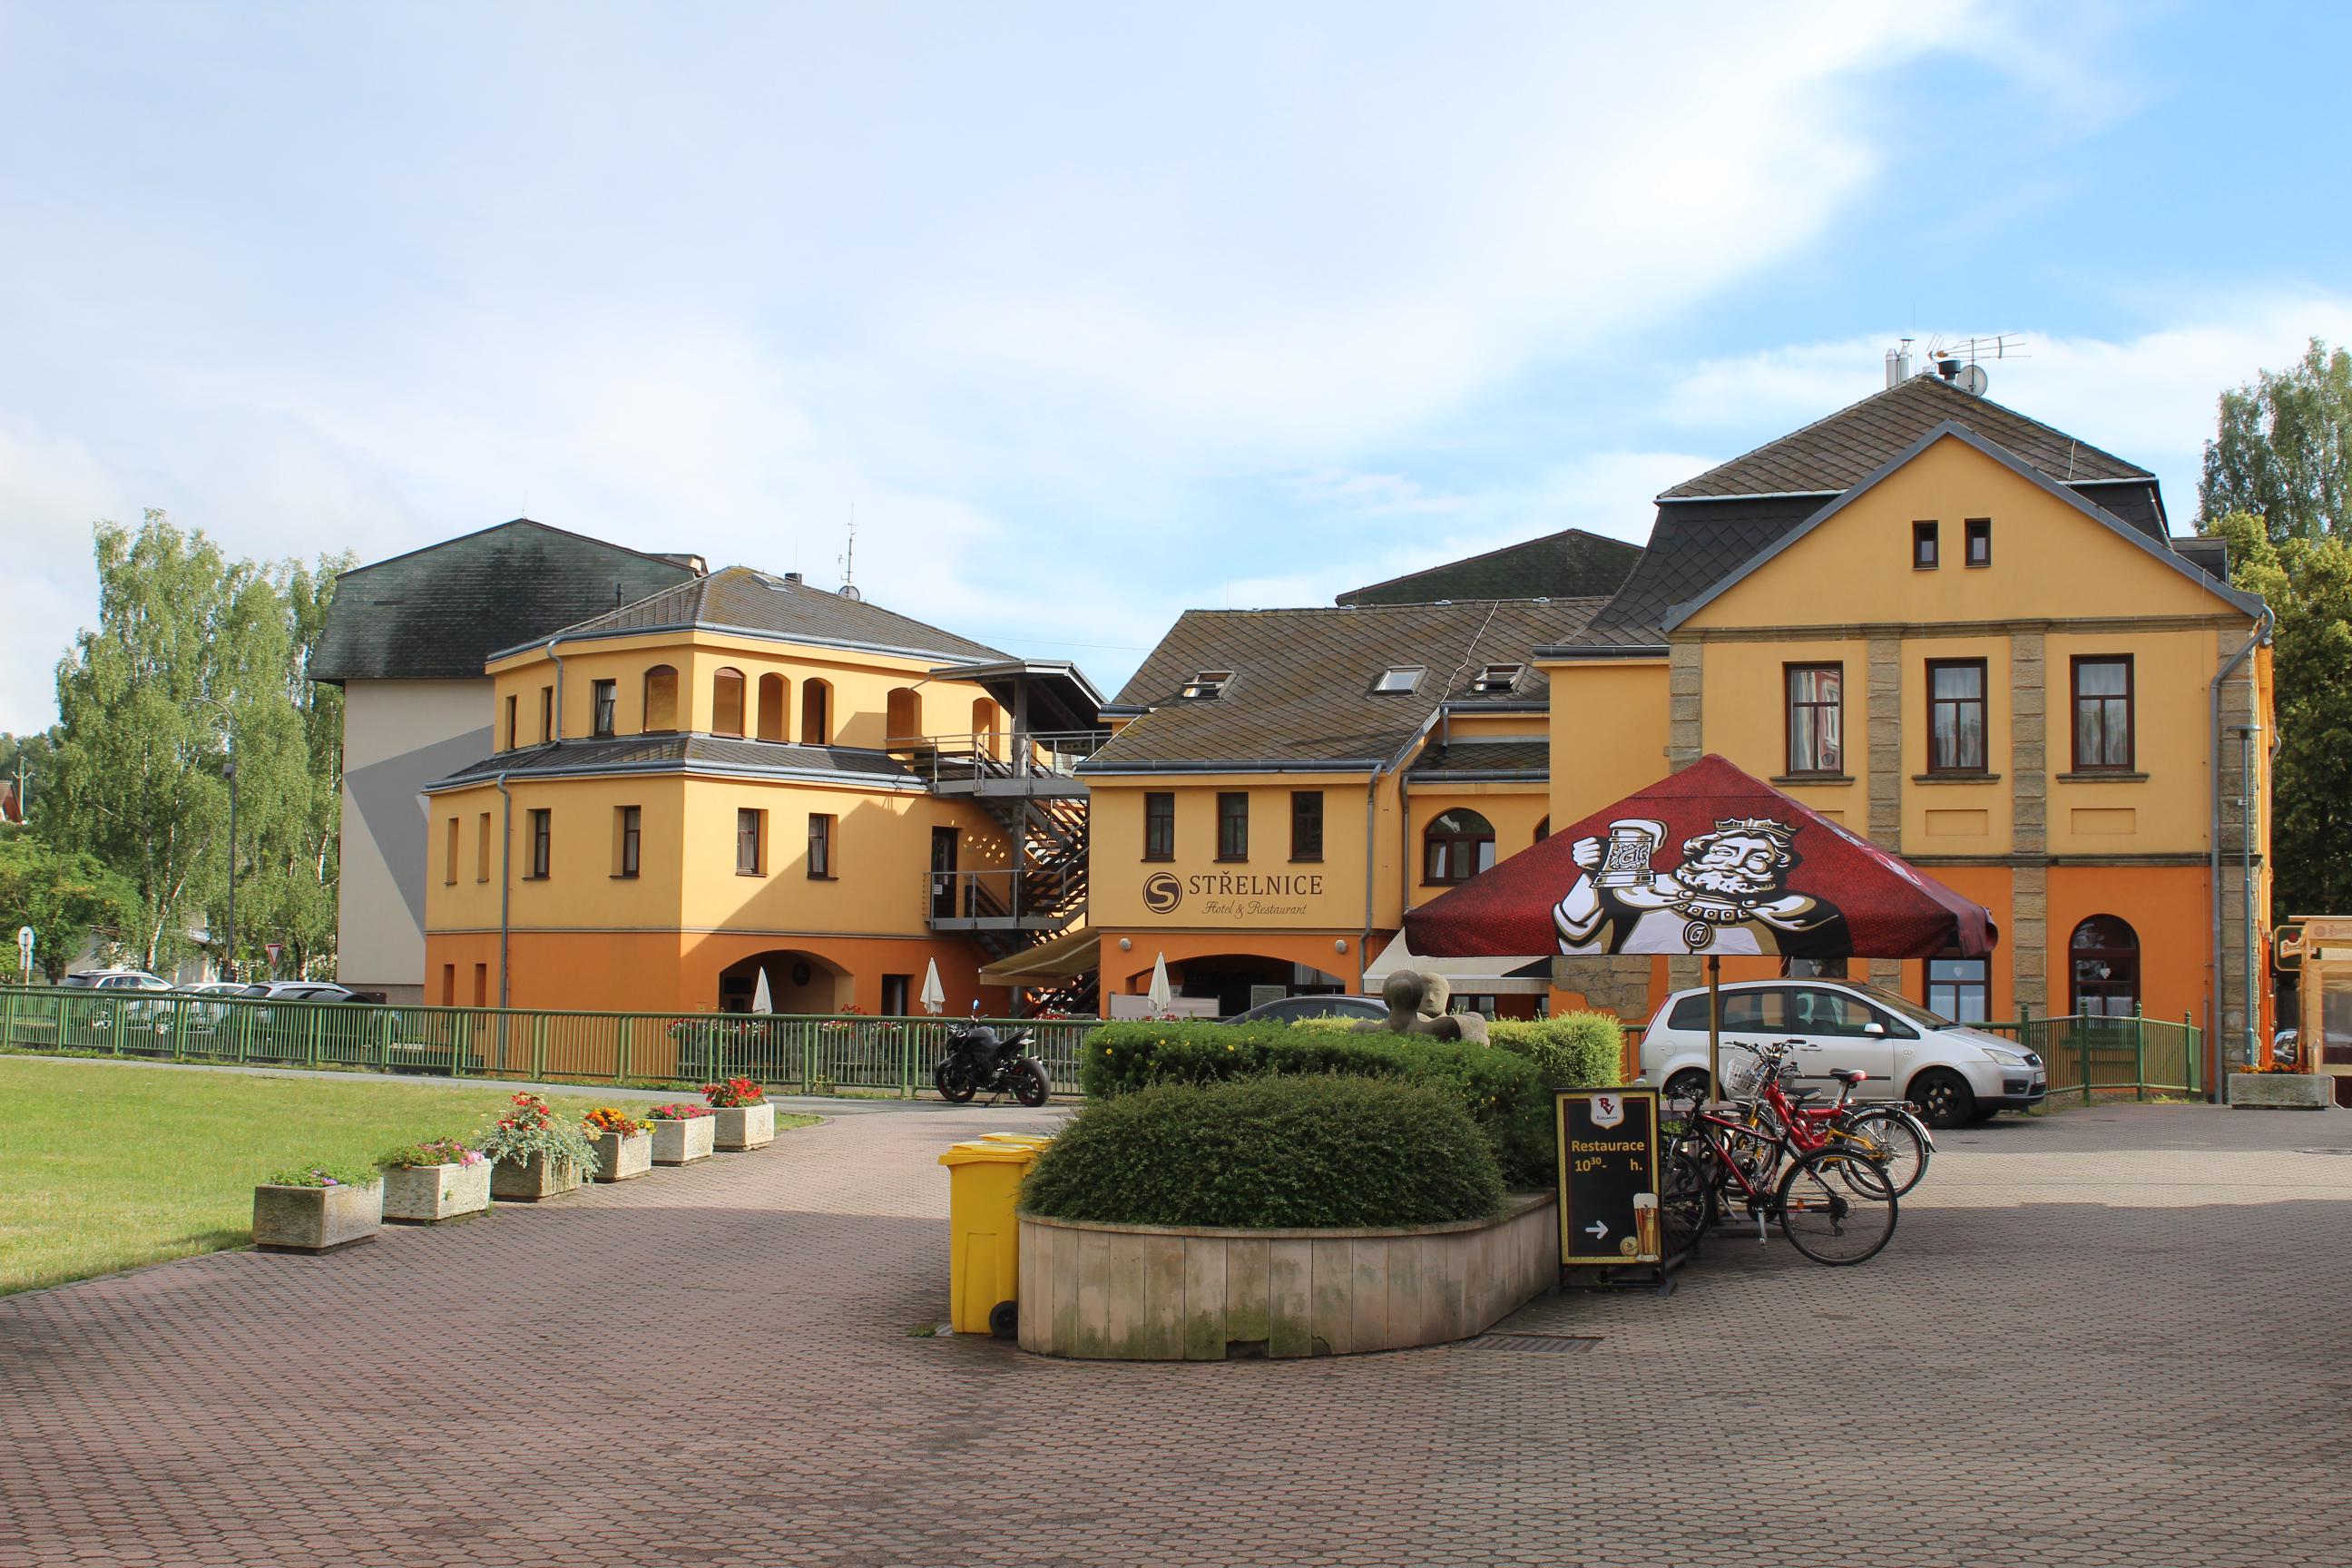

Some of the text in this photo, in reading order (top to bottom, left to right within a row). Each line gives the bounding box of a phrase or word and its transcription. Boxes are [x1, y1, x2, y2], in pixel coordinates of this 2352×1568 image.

[1189, 871, 1323, 895] STŘELNICE
[1201, 900, 1308, 919] Hotel & Restaurant
[1572, 1141, 1645, 1152] Restaurace
[1630, 1158, 1643, 1171] h.
